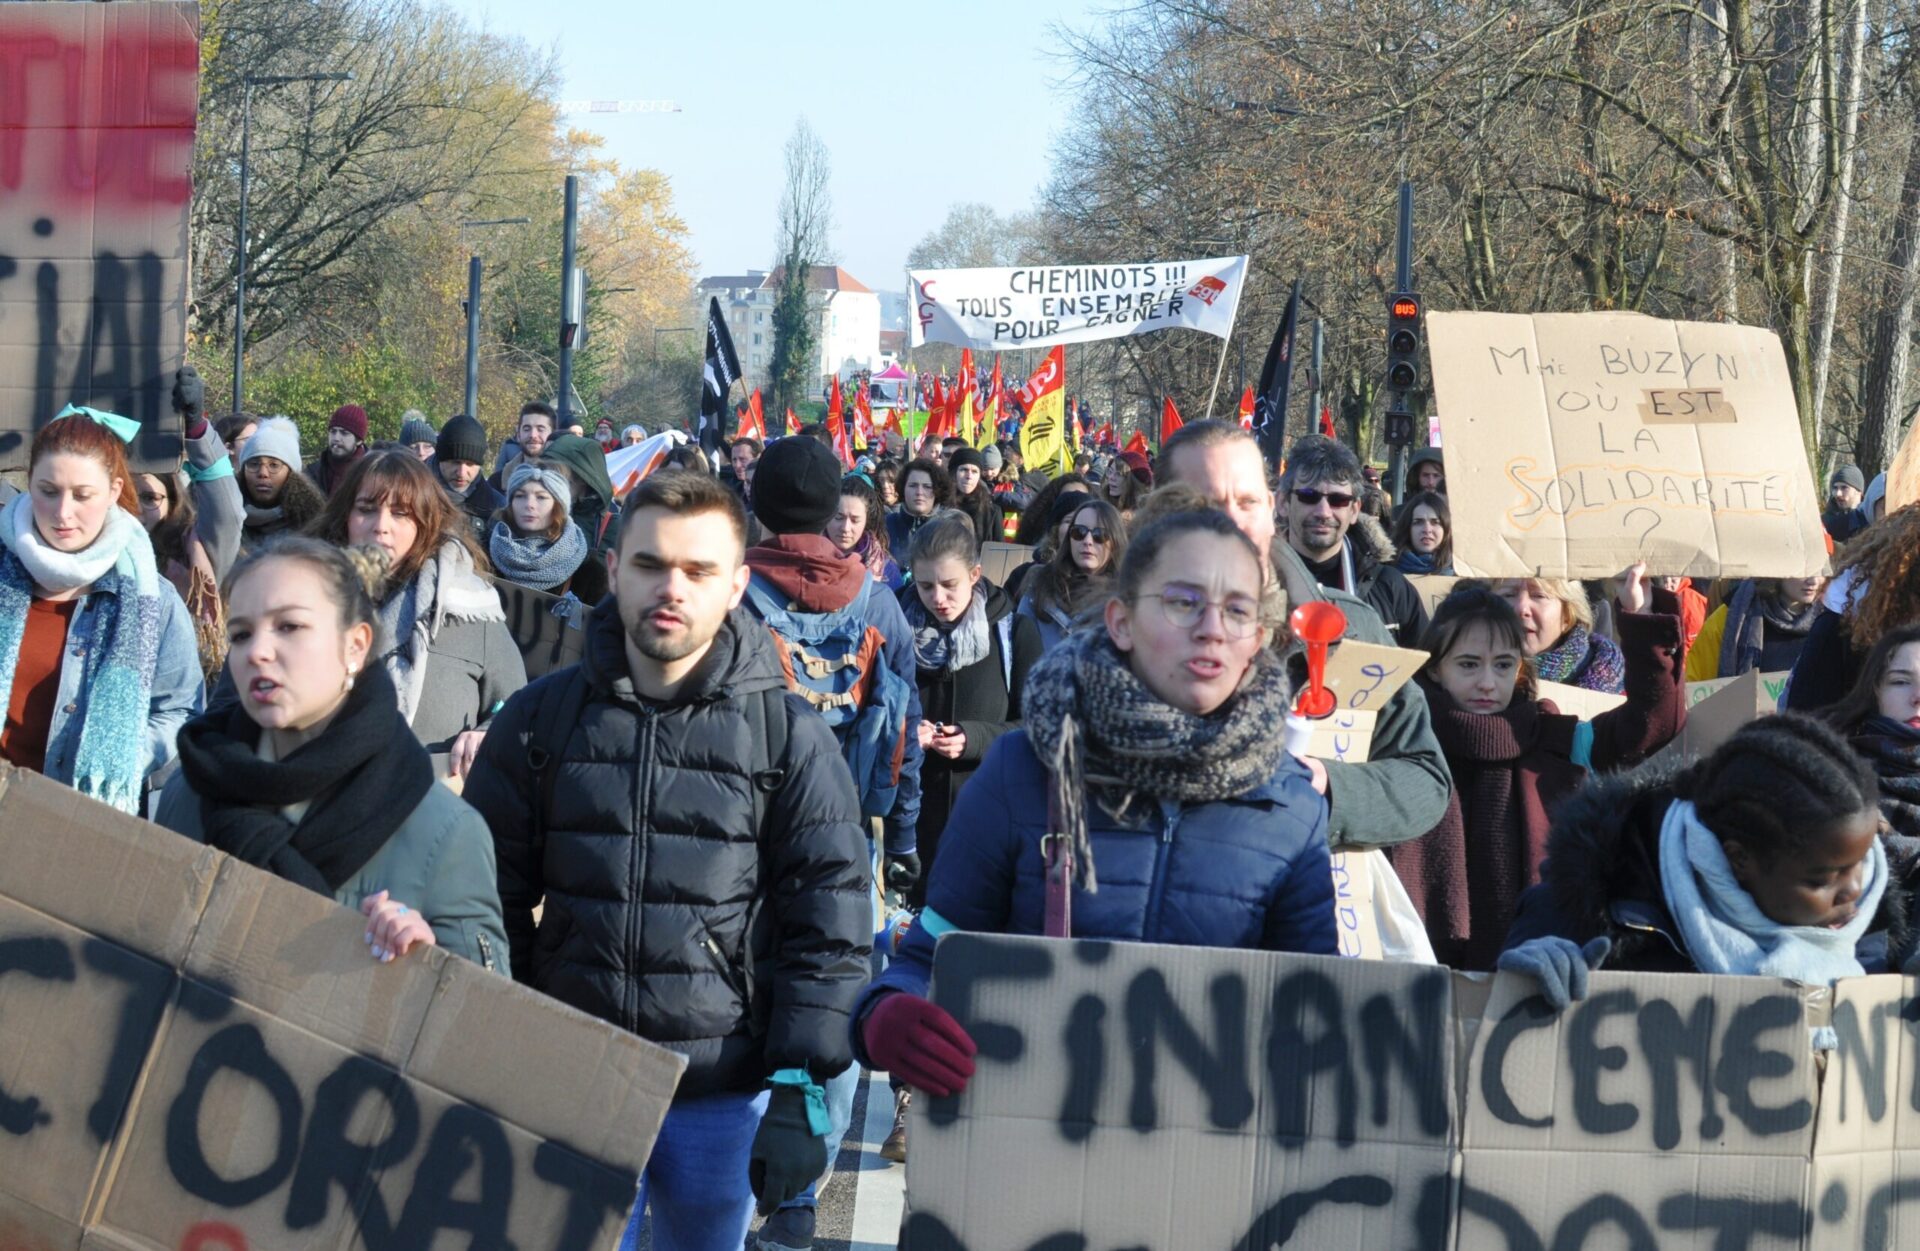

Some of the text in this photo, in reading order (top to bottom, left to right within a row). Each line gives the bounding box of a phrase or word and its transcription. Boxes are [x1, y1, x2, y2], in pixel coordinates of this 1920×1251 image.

[1009, 265, 1186, 294] CHEMINOTS !!!
[919, 279, 936, 338] CGT
[956, 285, 1186, 318] TOUS ENSEMBLE
[1395, 304, 1415, 315] BUS
[994, 301, 1183, 340] POUR GAGNER
[1600, 344, 1739, 381] BUZYN
[1556, 382, 1722, 416] OÙ EST
[1598, 421, 1660, 454] LA
[1623, 507, 1661, 550] ?
